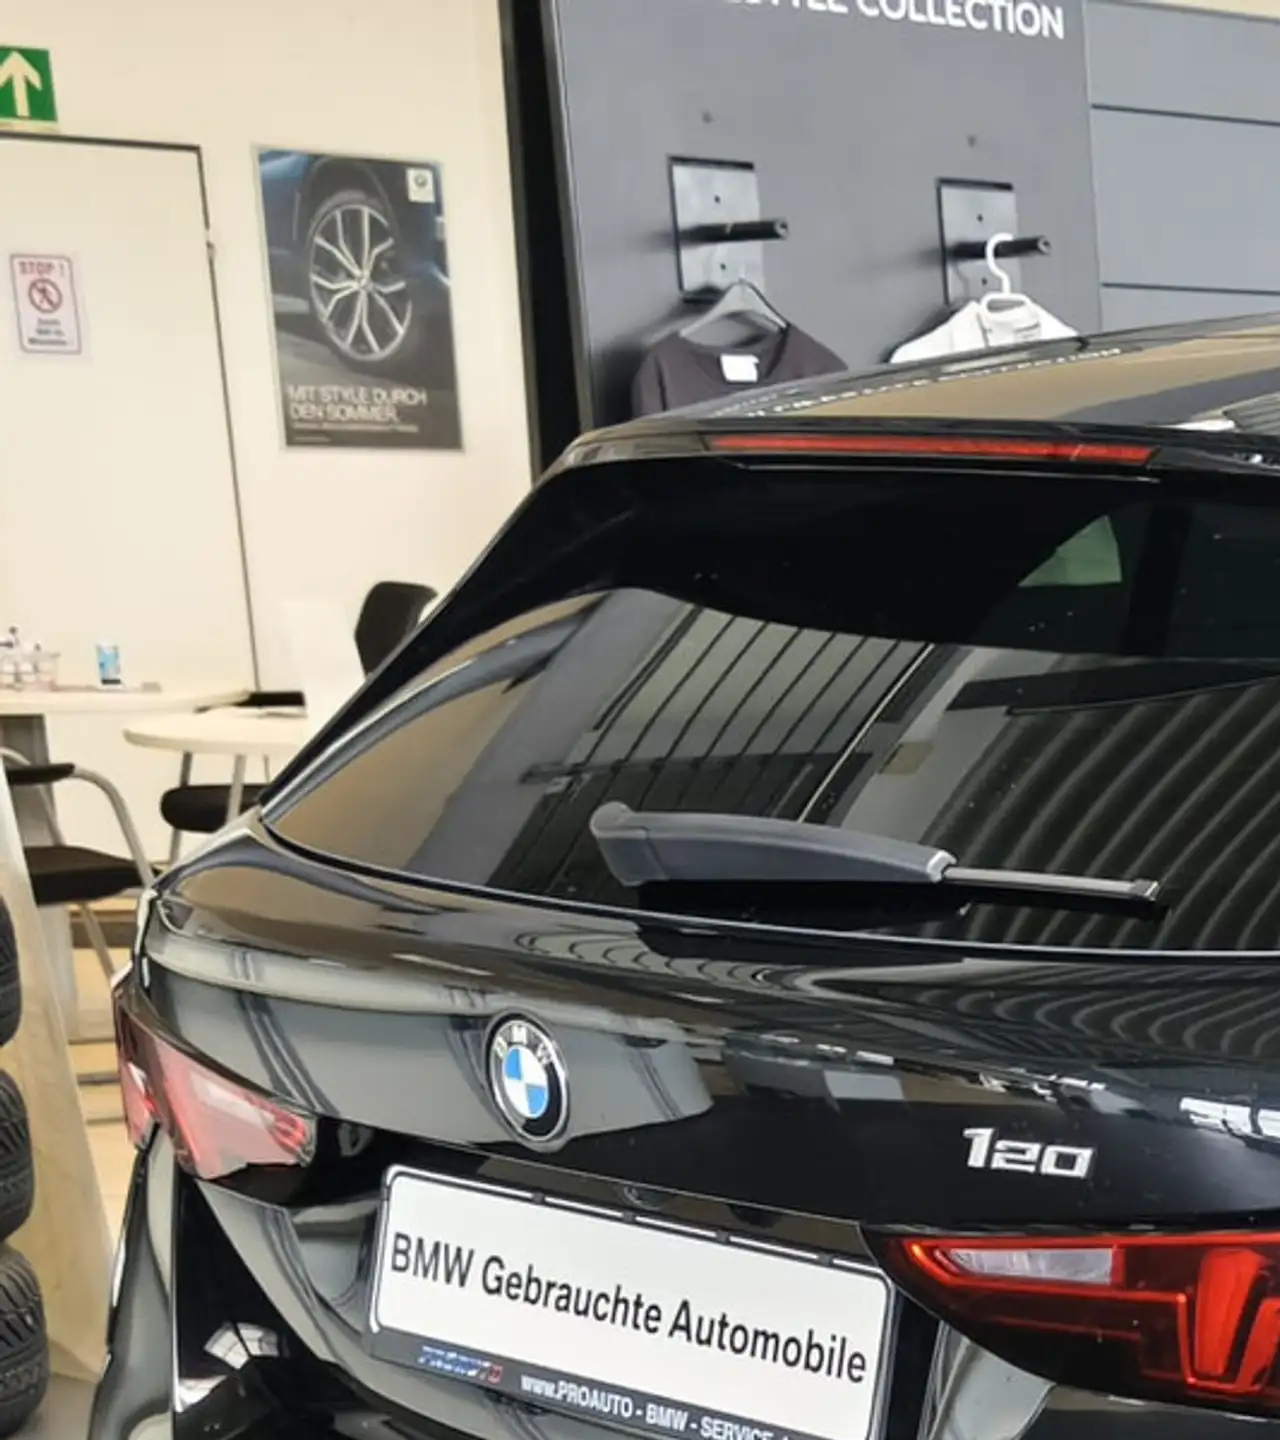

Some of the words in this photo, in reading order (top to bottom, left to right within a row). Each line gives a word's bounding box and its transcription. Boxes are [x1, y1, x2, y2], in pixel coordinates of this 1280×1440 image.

[859, 0, 1064, 39] COLLECTION
[19, 261, 55, 275] STOP
[319, 386, 370, 404] STYLE
[963, 1127, 1094, 1179] 120
[391, 1232, 474, 1288] BMW
[482, 1256, 661, 1334] Gebrauchte
[669, 1300, 867, 1383] Automobile
[521, 1375, 632, 1418] www.PROAUTO
[645, 1403, 688, 1431] BMW
